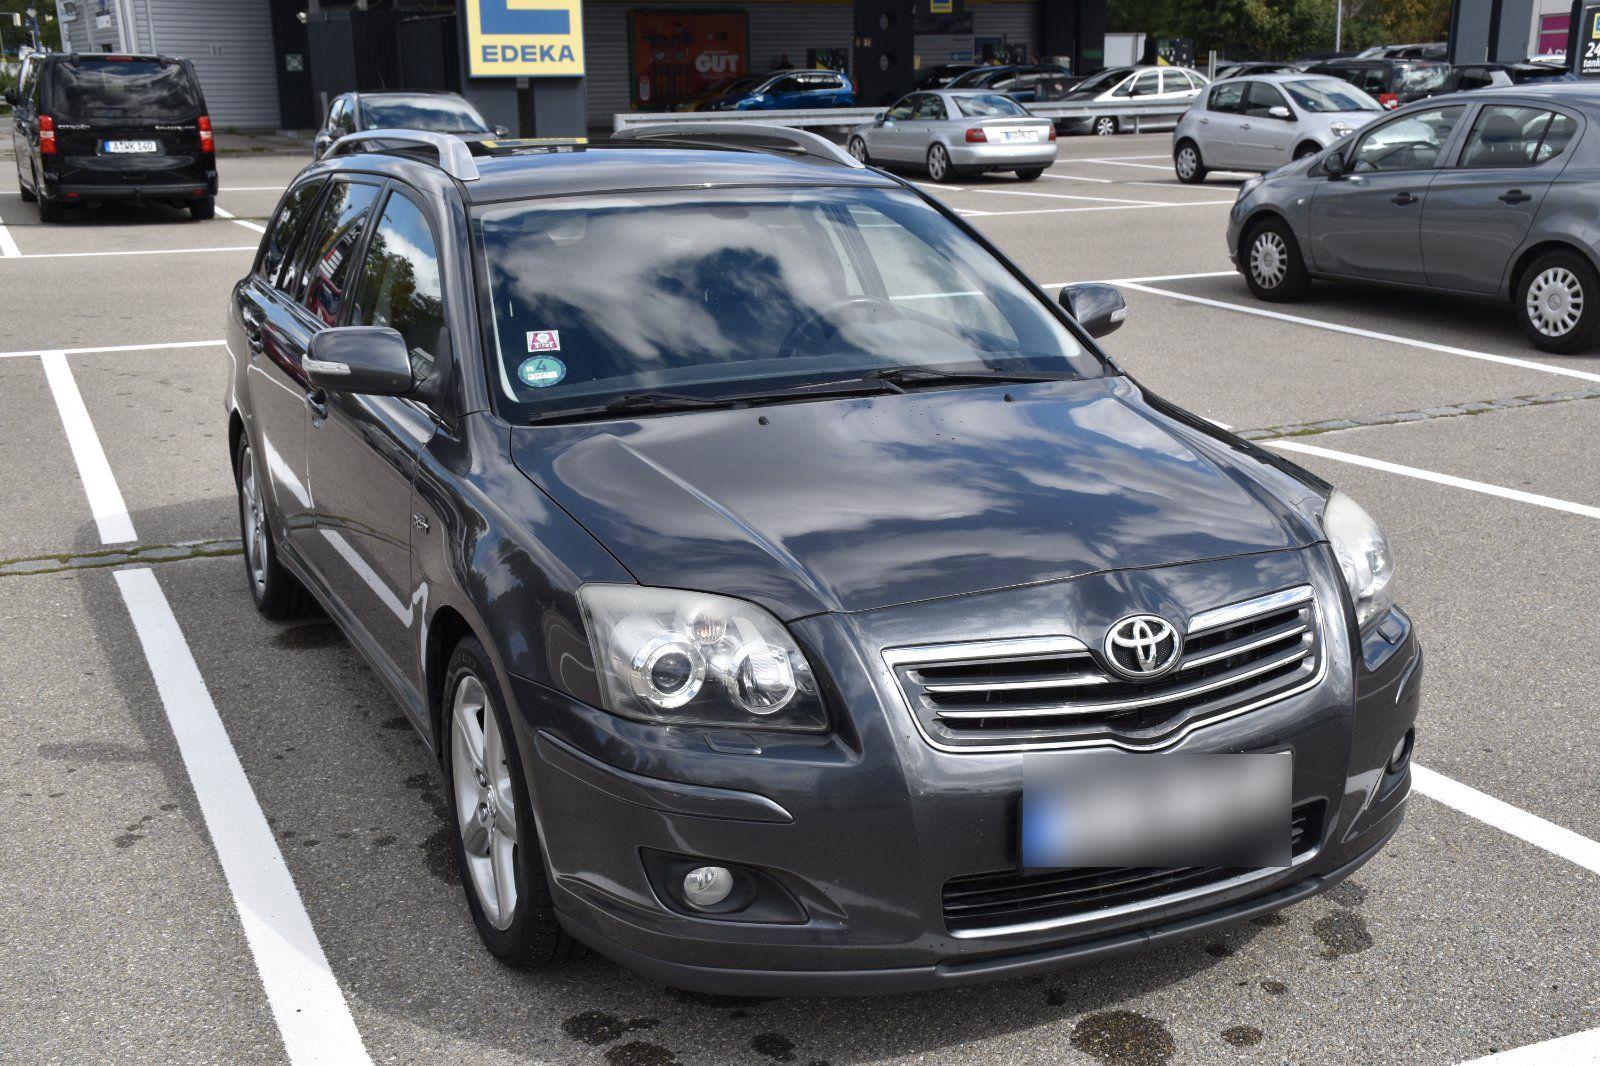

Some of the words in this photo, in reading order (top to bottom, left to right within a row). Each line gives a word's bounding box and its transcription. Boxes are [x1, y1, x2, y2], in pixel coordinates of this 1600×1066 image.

[481, 44, 575, 62] EDEKA
[695, 53, 738, 72] GUT
[536, 359, 548, 371] 4
